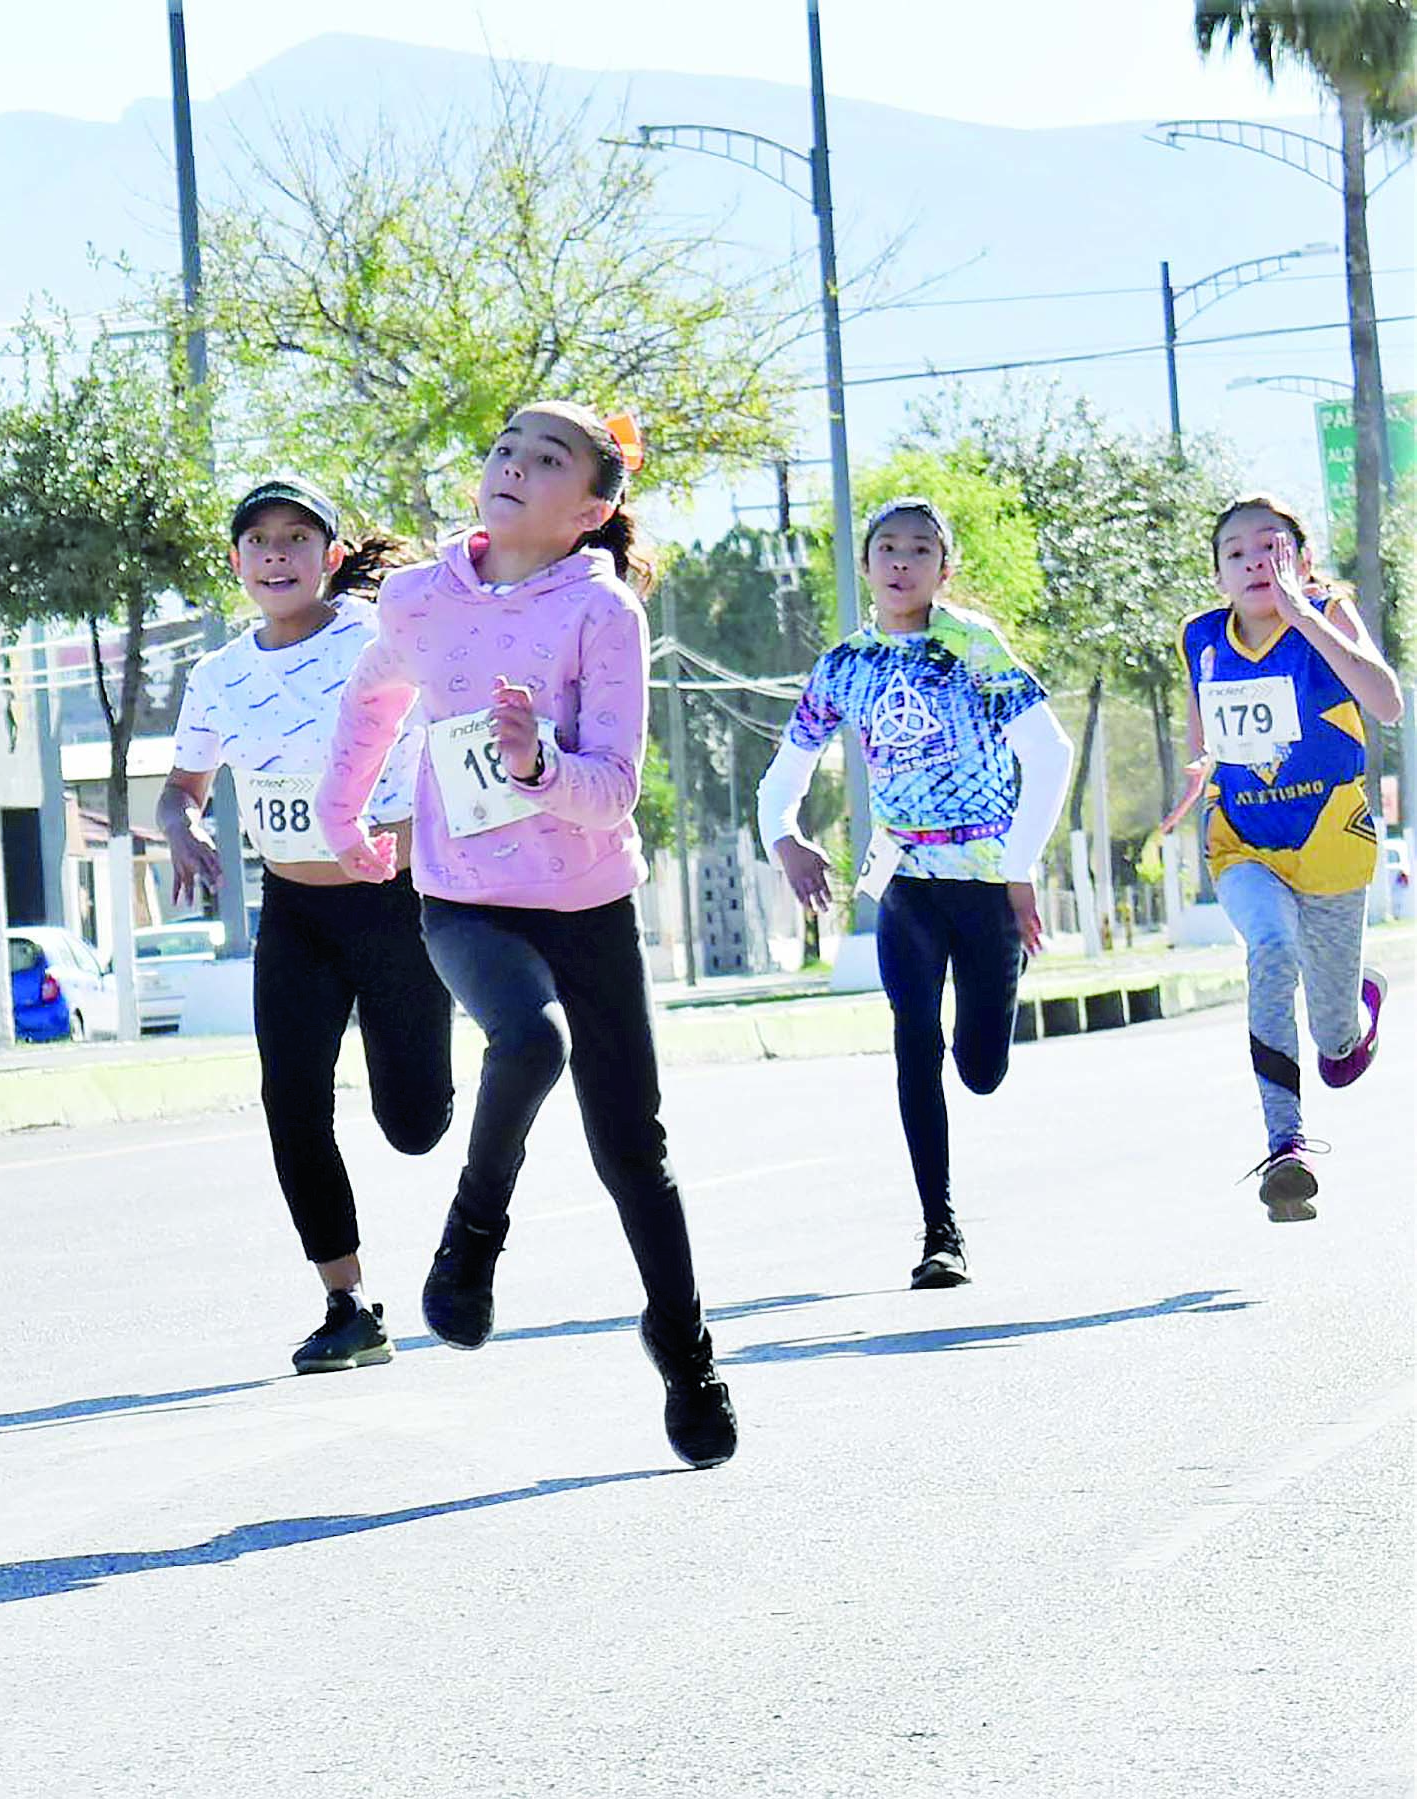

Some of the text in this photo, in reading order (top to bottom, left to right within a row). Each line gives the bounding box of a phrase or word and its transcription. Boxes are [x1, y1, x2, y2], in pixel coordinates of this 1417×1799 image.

[1215, 703, 1273, 737] 179
[464, 741, 507, 789] 18
[254, 797, 311, 833] 188
